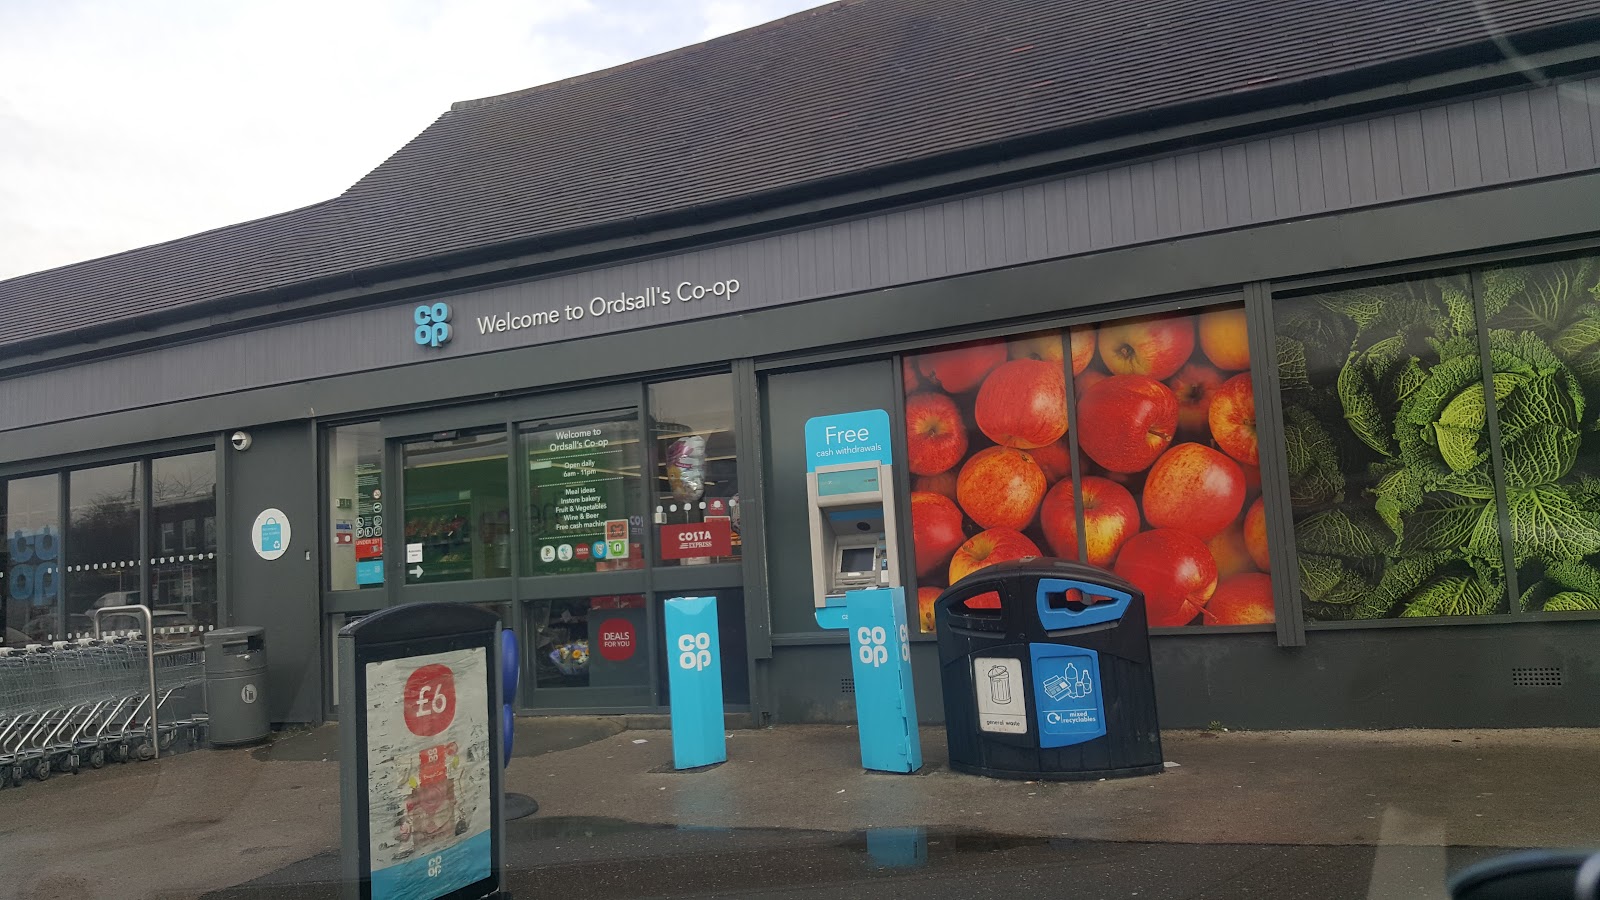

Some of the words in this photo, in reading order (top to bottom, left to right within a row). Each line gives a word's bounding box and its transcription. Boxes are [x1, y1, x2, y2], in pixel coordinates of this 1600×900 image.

[477, 309, 560, 335] Welcome
[565, 305, 584, 320] to
[589, 286, 671, 317] Ordsall's
[677, 279, 740, 301] Co-op
[555, 430, 591, 440] Welcome
[593, 428, 601, 436] to
[825, 425, 869, 445] Free
[549, 441, 583, 452] Ordsall's
[584, 439, 609, 448] Co-op
[816, 448, 833, 458] cash
[836, 443, 882, 455] withdrawals
[564, 462, 580, 470] Open
[581, 459, 596, 468] daily
[563, 470, 576, 478] 6am
[560, 497, 580, 505] Instore
[581, 495, 602, 503] bakery
[575, 503, 607, 512] Vegetables
[678, 530, 712, 542] COSTA
[688, 541, 712, 549] EXPRESS
[603, 631, 630, 641] DEALS
[416, 684, 447, 717] £6
[1062, 716, 1096, 725] recyclables
